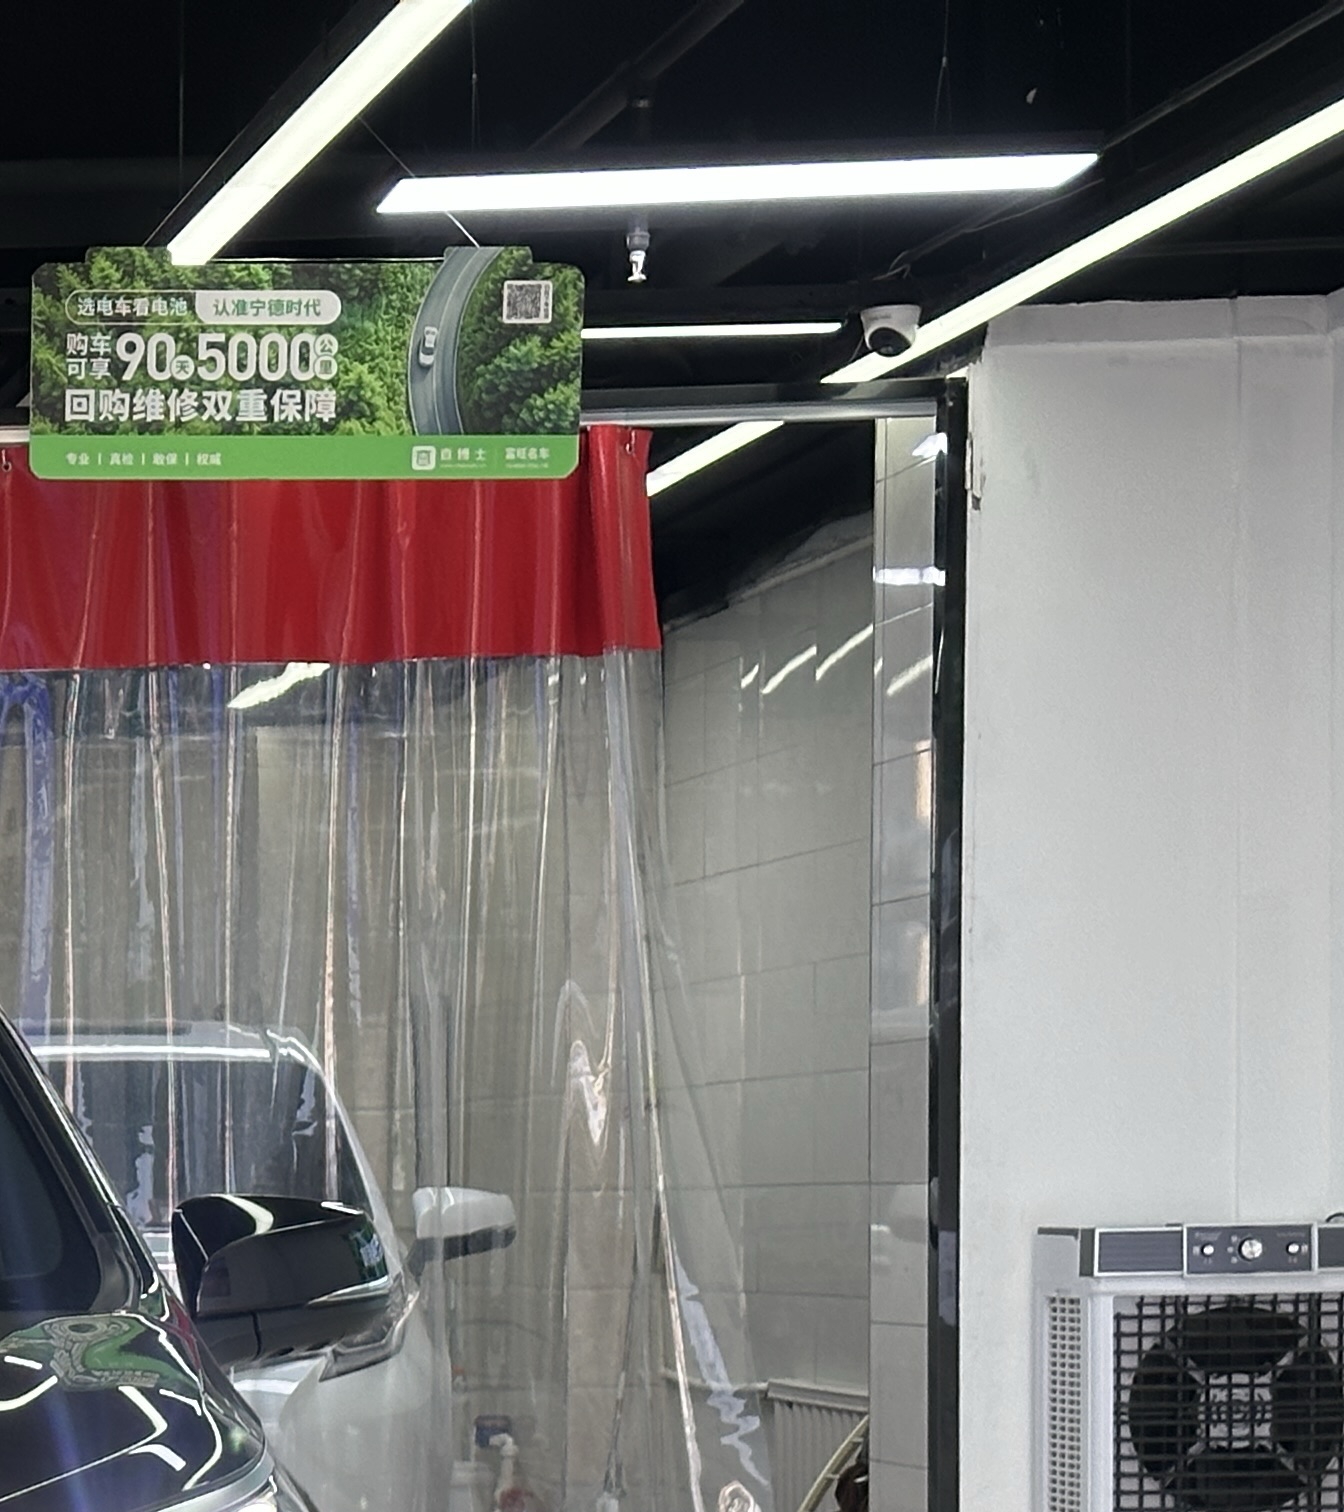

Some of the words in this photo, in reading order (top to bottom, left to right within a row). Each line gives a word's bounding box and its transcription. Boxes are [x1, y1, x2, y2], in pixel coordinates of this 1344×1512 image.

[77, 297, 188, 318] 选电车看电池
[213, 298, 321, 318] 认准宁德时代
[66, 333, 111, 356] 购车
[67, 357, 111, 381] 可享
[65, 388, 337, 423] 回购维修双重保障
